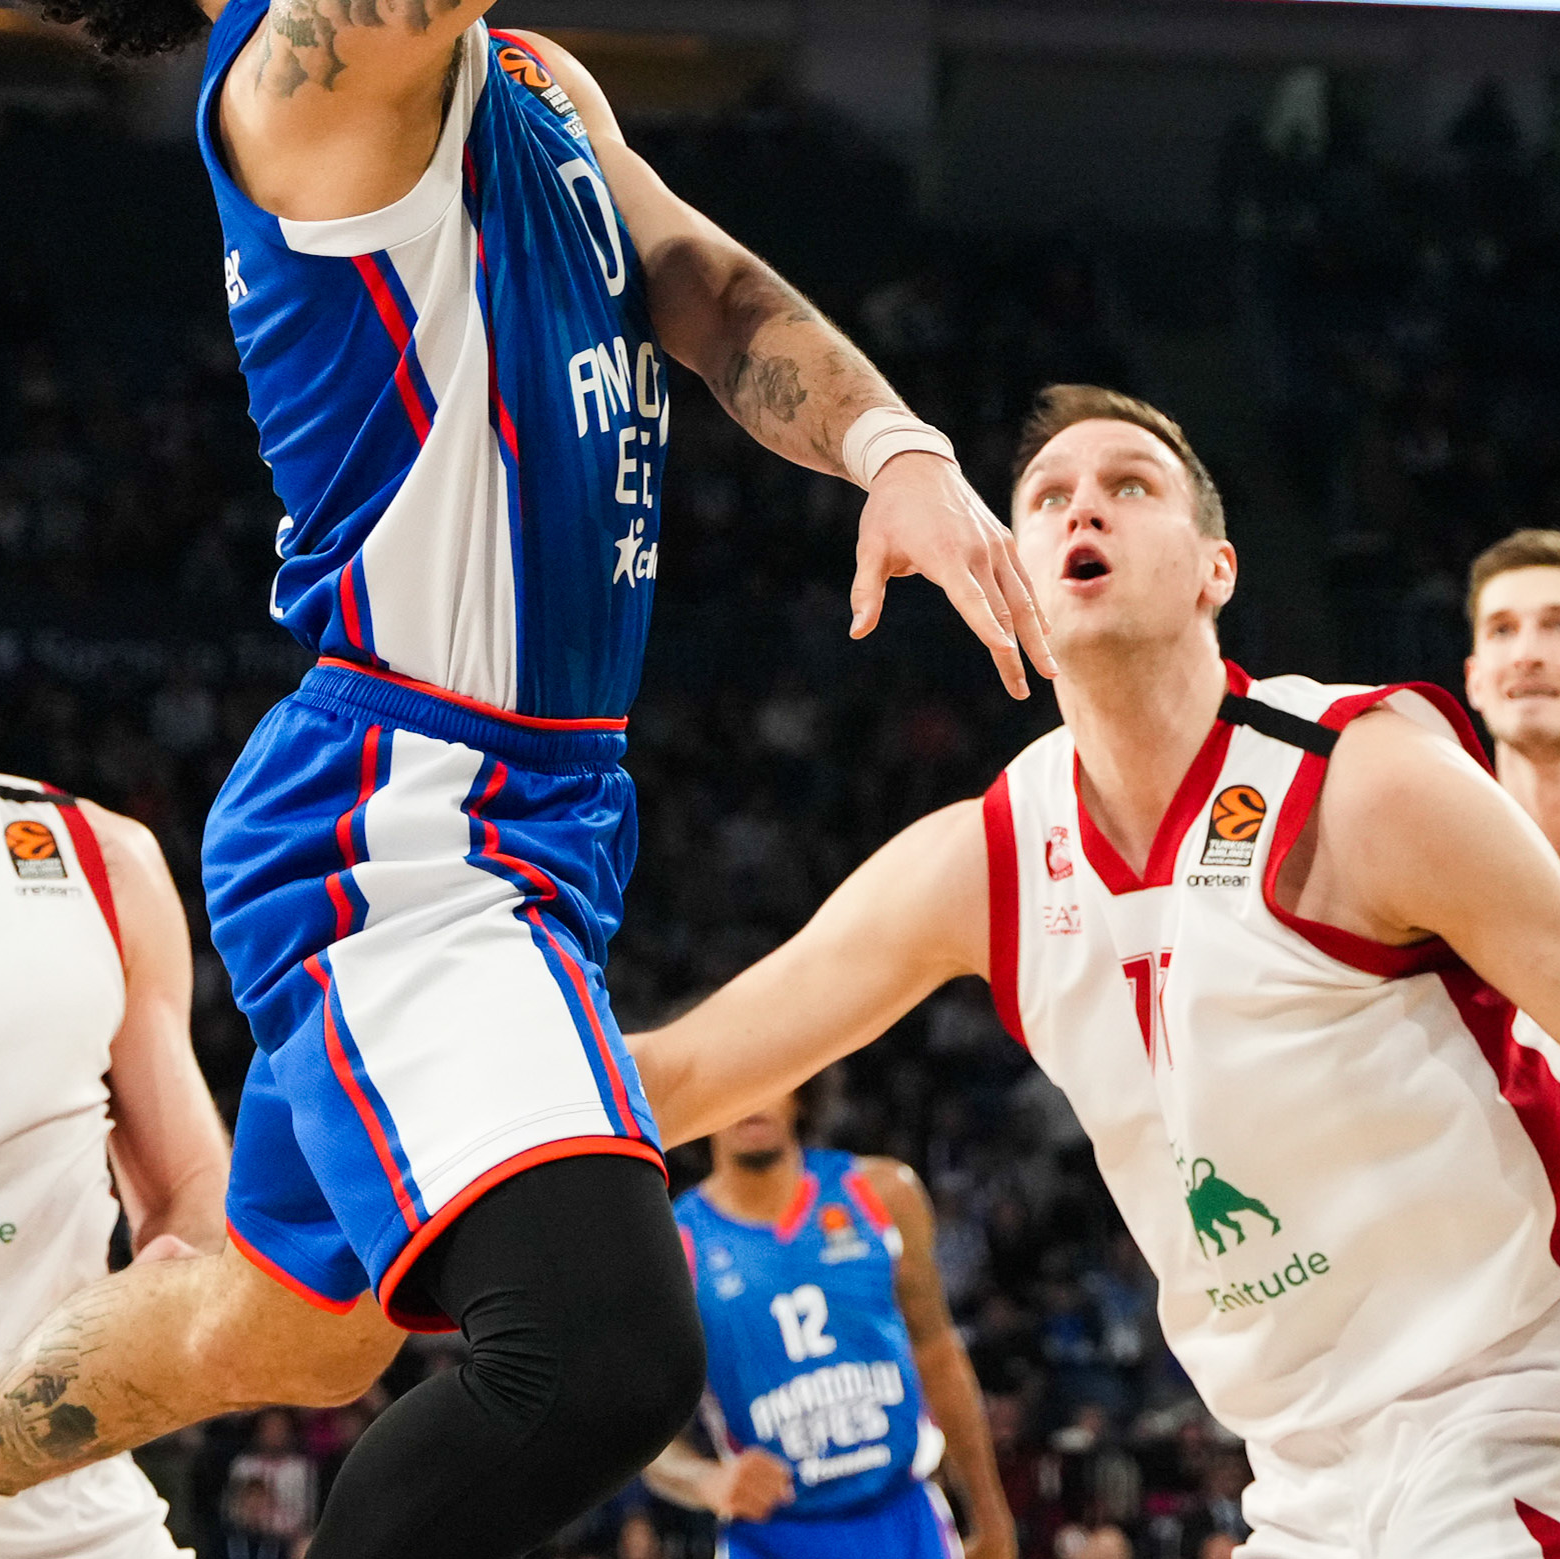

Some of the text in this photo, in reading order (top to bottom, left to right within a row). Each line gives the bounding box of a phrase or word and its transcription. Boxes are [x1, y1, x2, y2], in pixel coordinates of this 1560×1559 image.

[1121, 949, 1173, 1074] 1
[1205, 1252, 1331, 1312] nitude
[770, 1284, 837, 1362] 12
